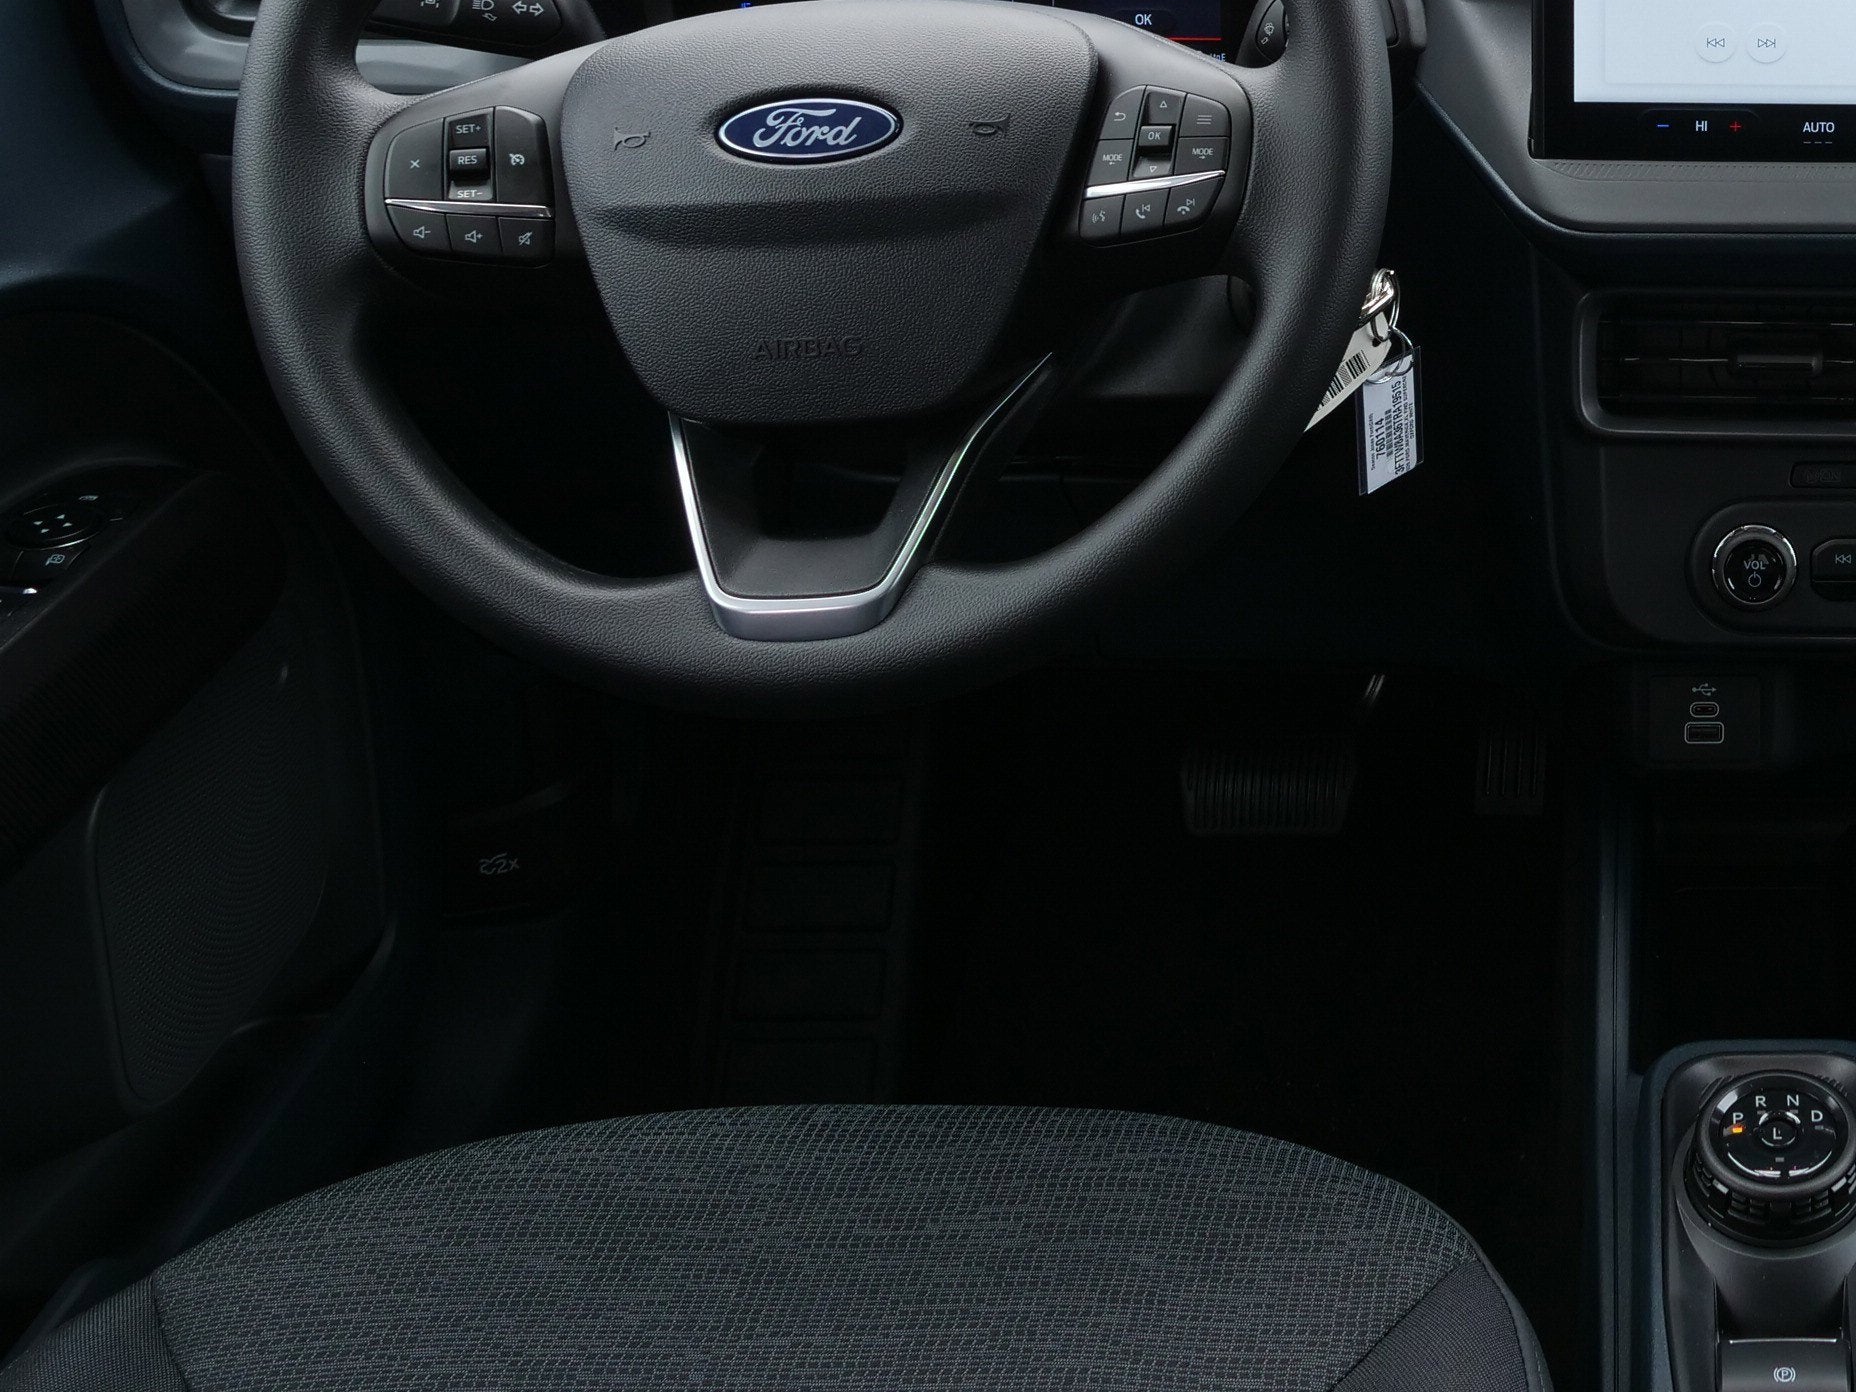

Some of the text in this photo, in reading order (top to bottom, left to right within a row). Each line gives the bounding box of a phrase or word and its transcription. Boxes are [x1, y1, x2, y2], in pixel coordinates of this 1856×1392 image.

[1135, 13, 1153, 26] OK
[752, 107, 863, 149] Ford
[1695, 121, 1708, 132] HI
[1802, 121, 1836, 134] AUTO
[1147, 131, 1162, 141] OK
[1102, 153, 1123, 162] MODE
[1192, 147, 1214, 156] MODE
[457, 155, 478, 165] RES
[754, 337, 863, 359] AIRBAG
[1375, 417, 1386, 460] 760114
[1743, 559, 1767, 571] VOL
[1732, 1094, 1824, 1125] P R N D
[1772, 1127, 1783, 1140] L
